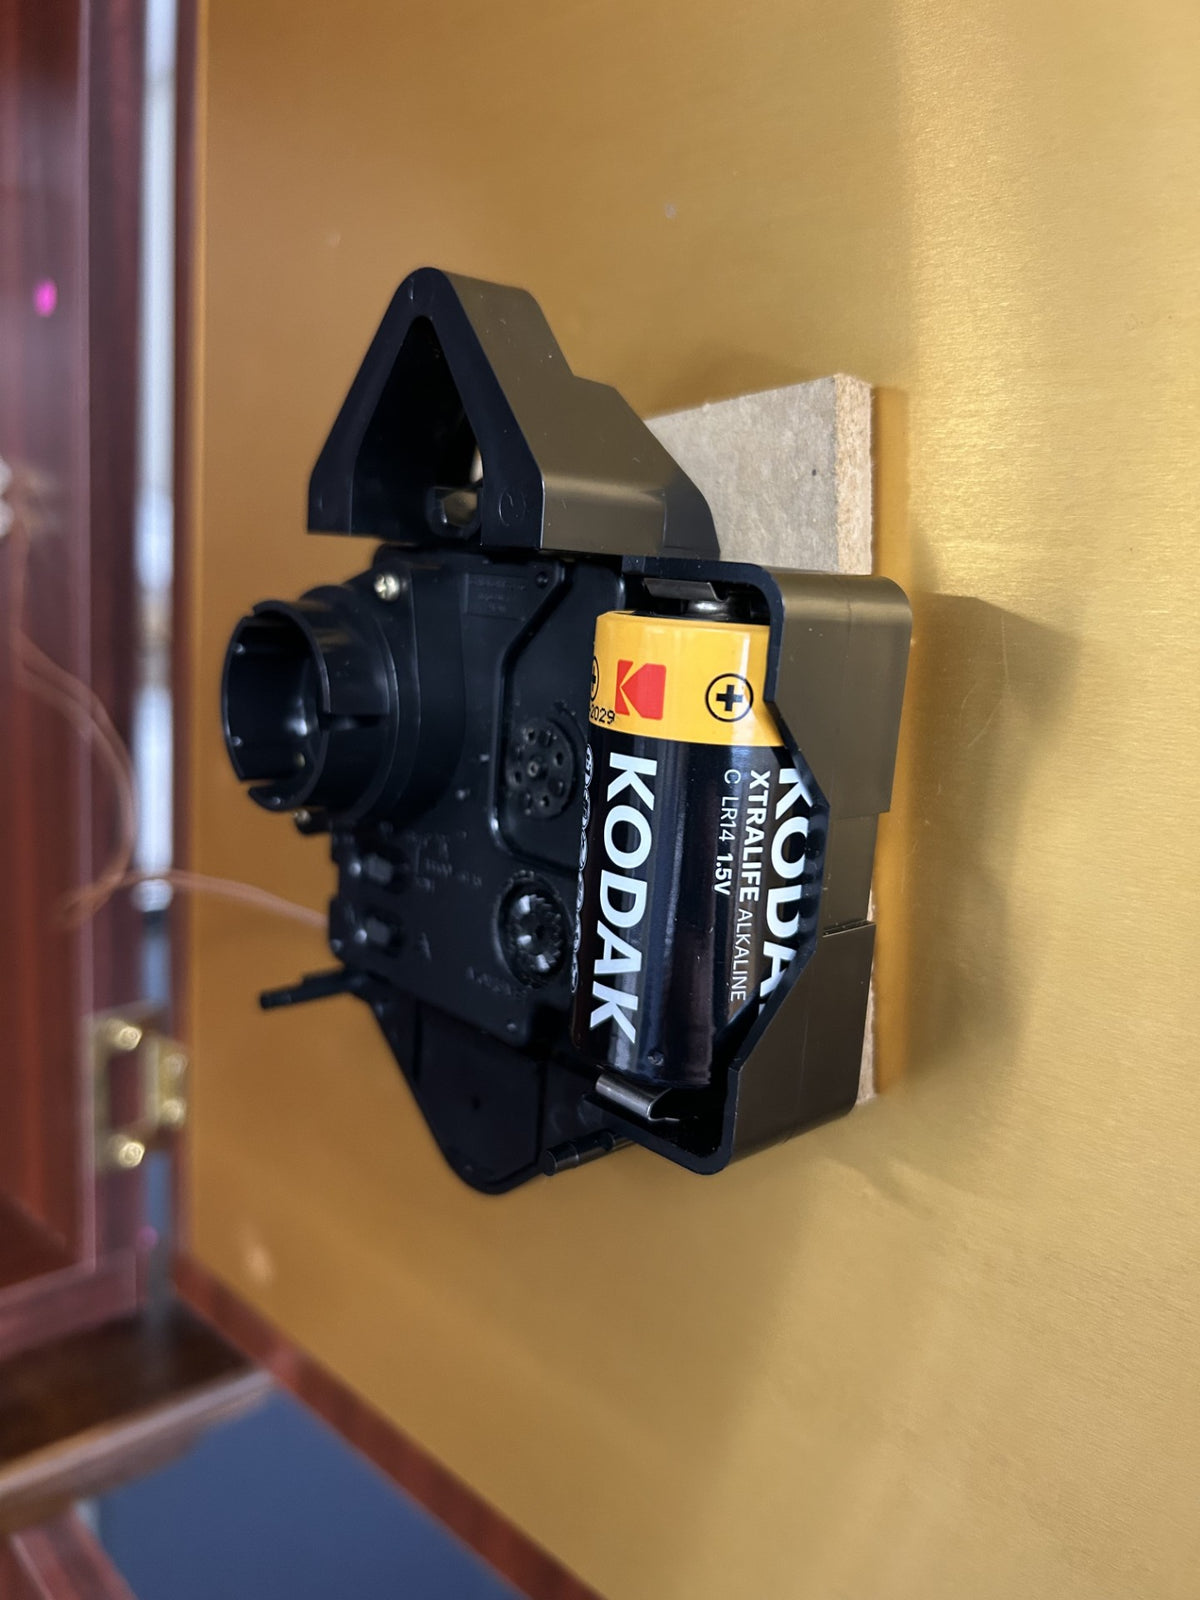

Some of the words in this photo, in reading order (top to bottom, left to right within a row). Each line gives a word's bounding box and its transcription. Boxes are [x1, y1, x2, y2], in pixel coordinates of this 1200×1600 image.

[719, 796, 738, 841] LR14
[724, 769, 741, 784] C
[714, 853, 734, 895] 1.5V
[739, 770, 771, 902] XTRALIFE
[590, 752, 657, 1044] KODAK
[760, 768, 813, 1015] KODA
[730, 908, 752, 1002] ALKALINE
